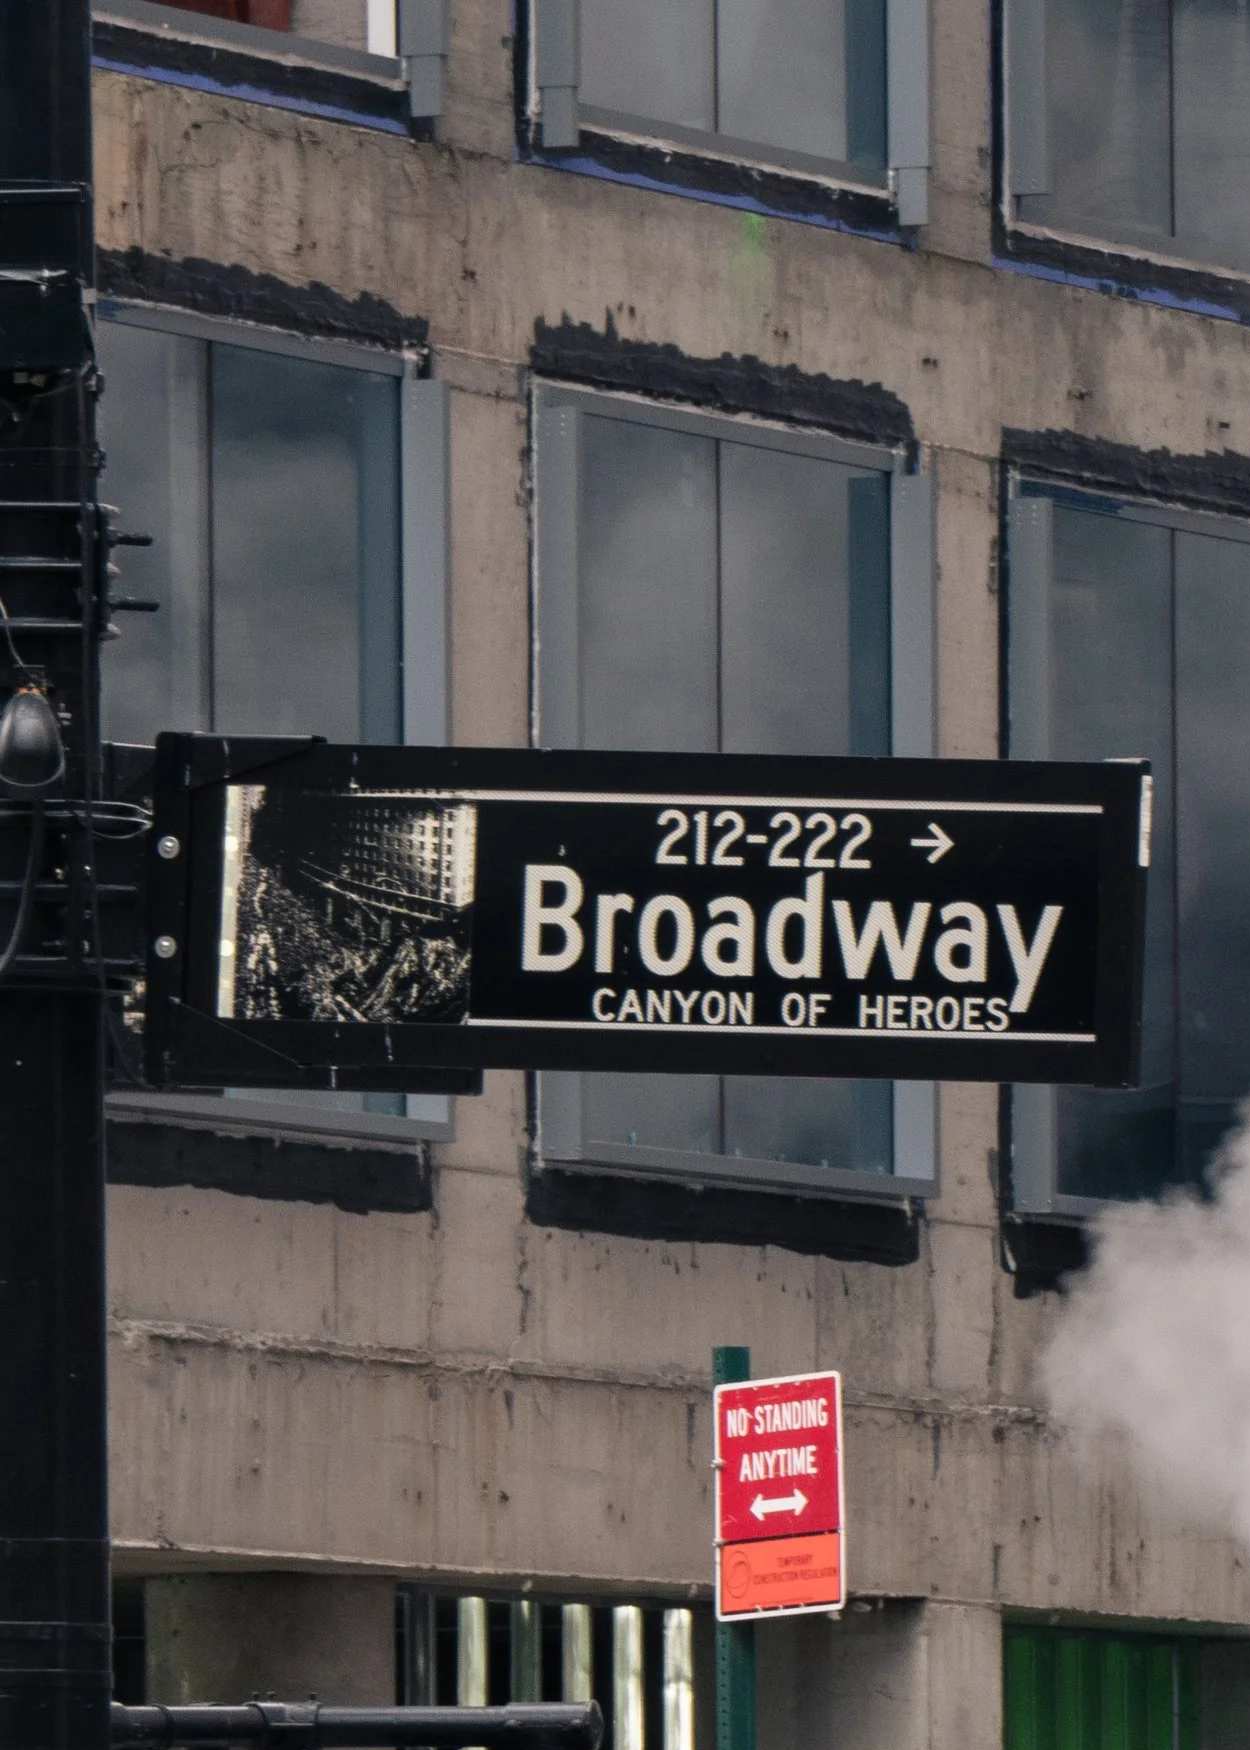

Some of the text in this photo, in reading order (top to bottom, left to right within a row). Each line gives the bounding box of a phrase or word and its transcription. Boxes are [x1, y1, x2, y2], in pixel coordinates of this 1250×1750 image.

[655, 808, 872, 869] 212-222
[520, 863, 1063, 1012] Broadway
[591, 987, 1011, 1033] CANYON OF HEROES
[727, 1398, 828, 1438] NO STANDING
[739, 1445, 818, 1482] ANYTIME
